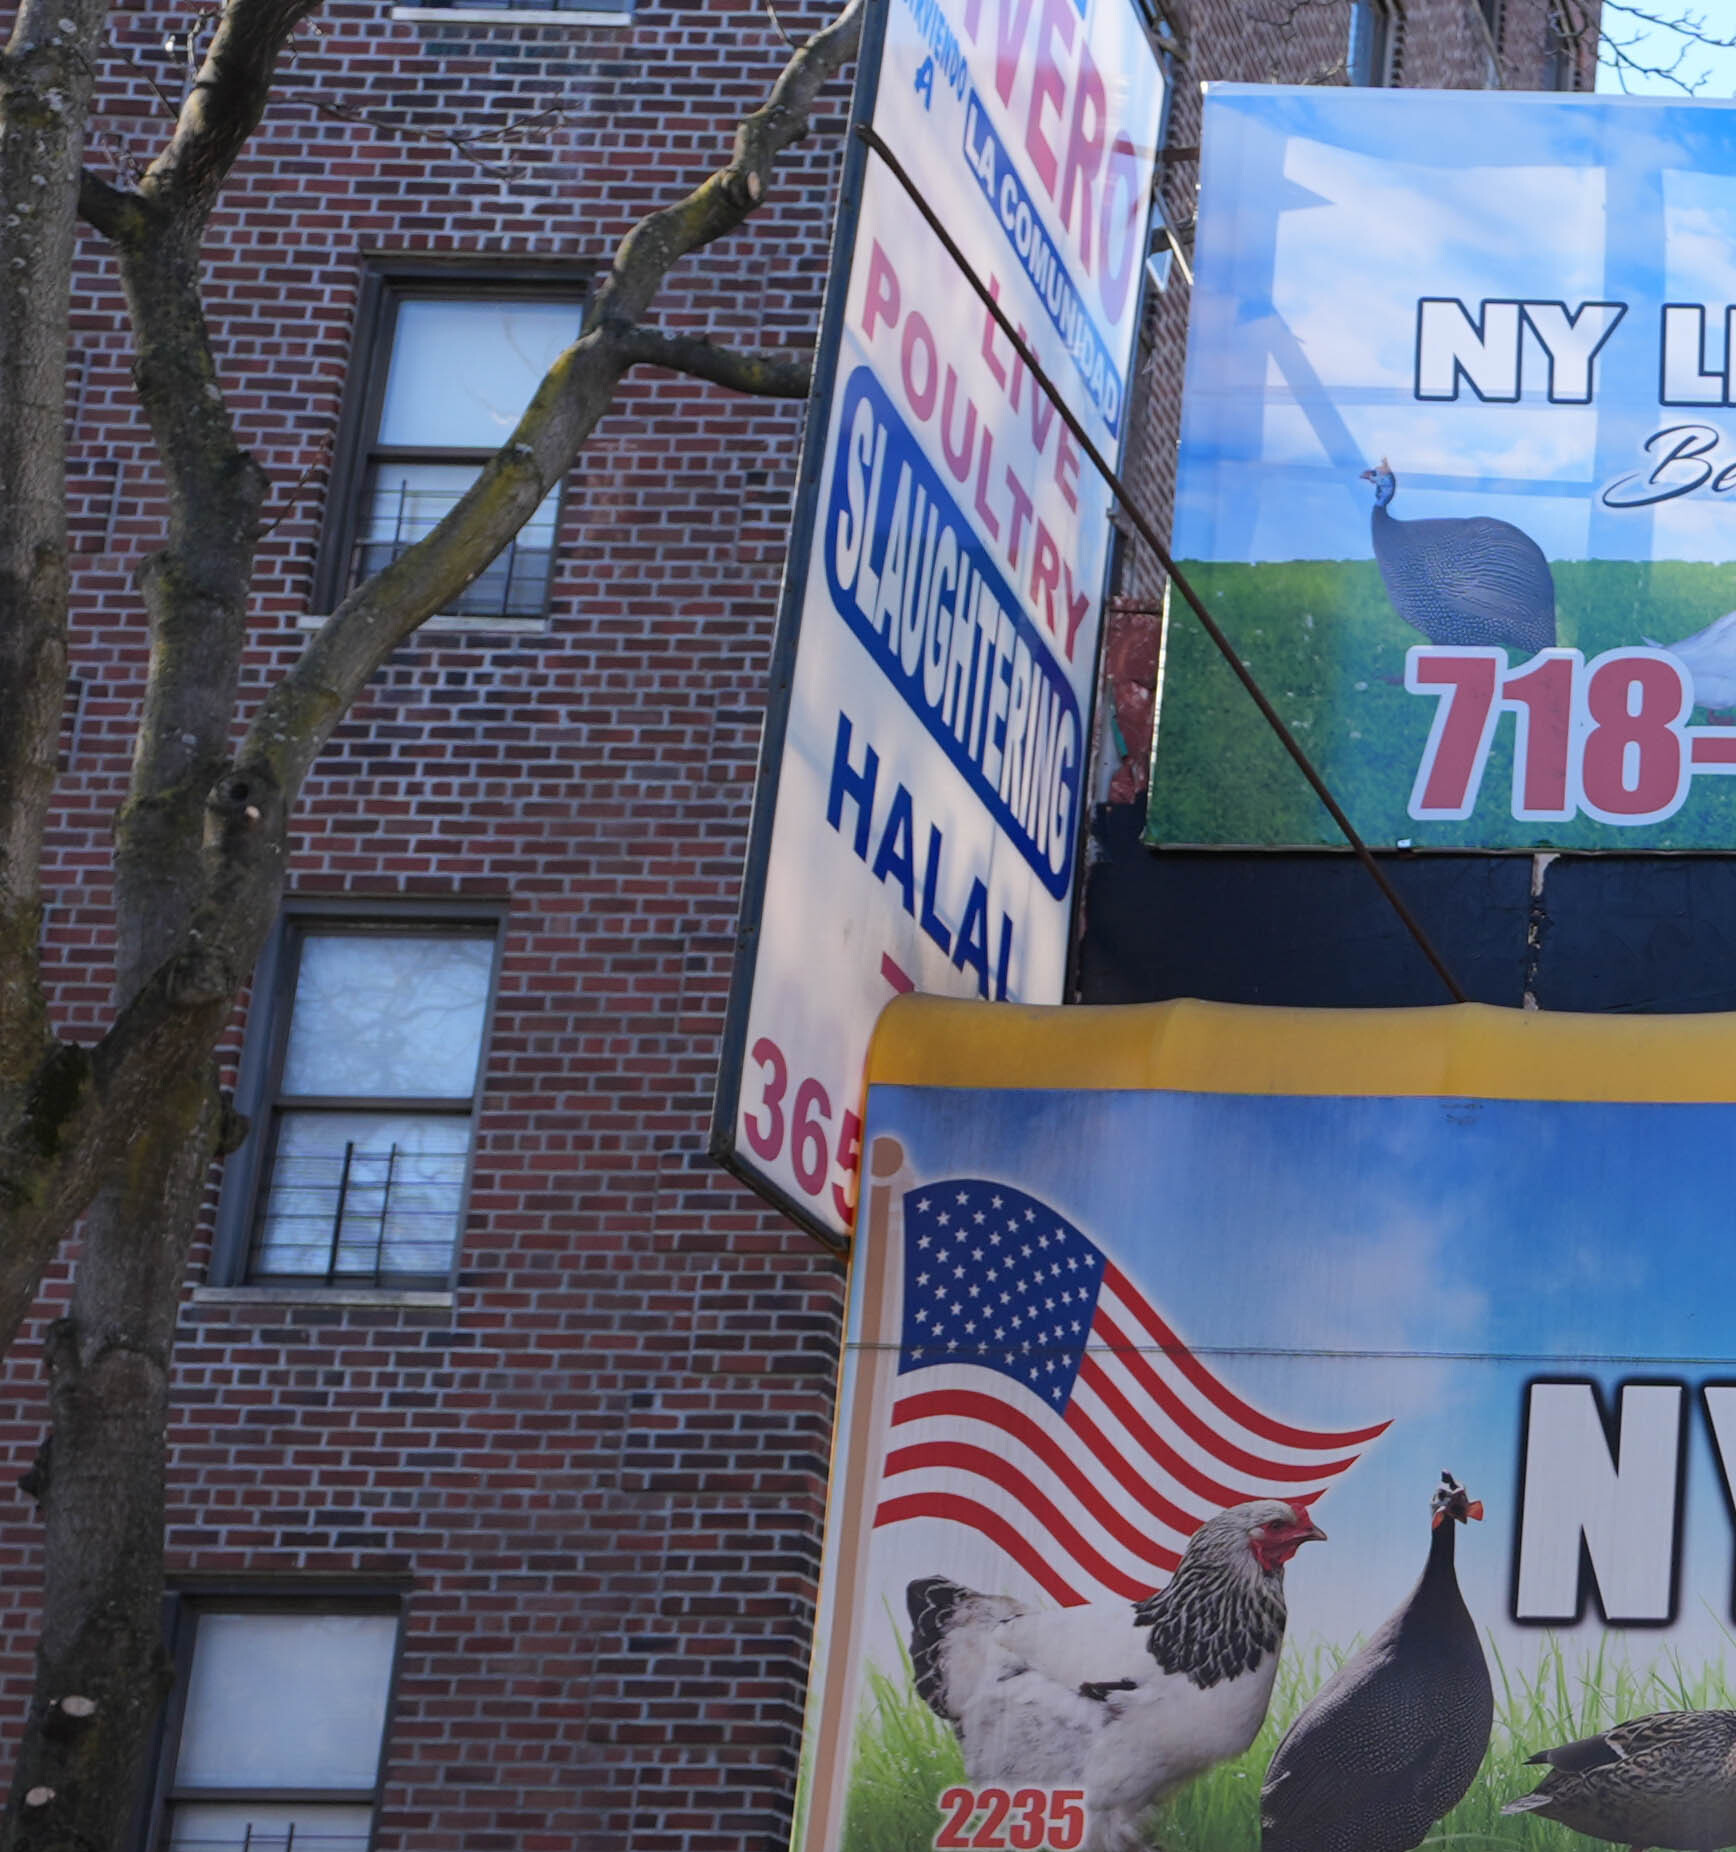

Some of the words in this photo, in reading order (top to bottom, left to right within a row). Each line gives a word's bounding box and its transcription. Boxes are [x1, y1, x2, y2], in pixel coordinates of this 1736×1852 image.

[964, 102, 996, 198] LA
[1001, 173, 1121, 421] COMUNIDAD
[979, 272, 1083, 516] LIVE
[1413, 297, 1627, 403] NY
[860, 236, 1090, 664] POULTRY
[836, 396, 1076, 874] SLAUGHTERING
